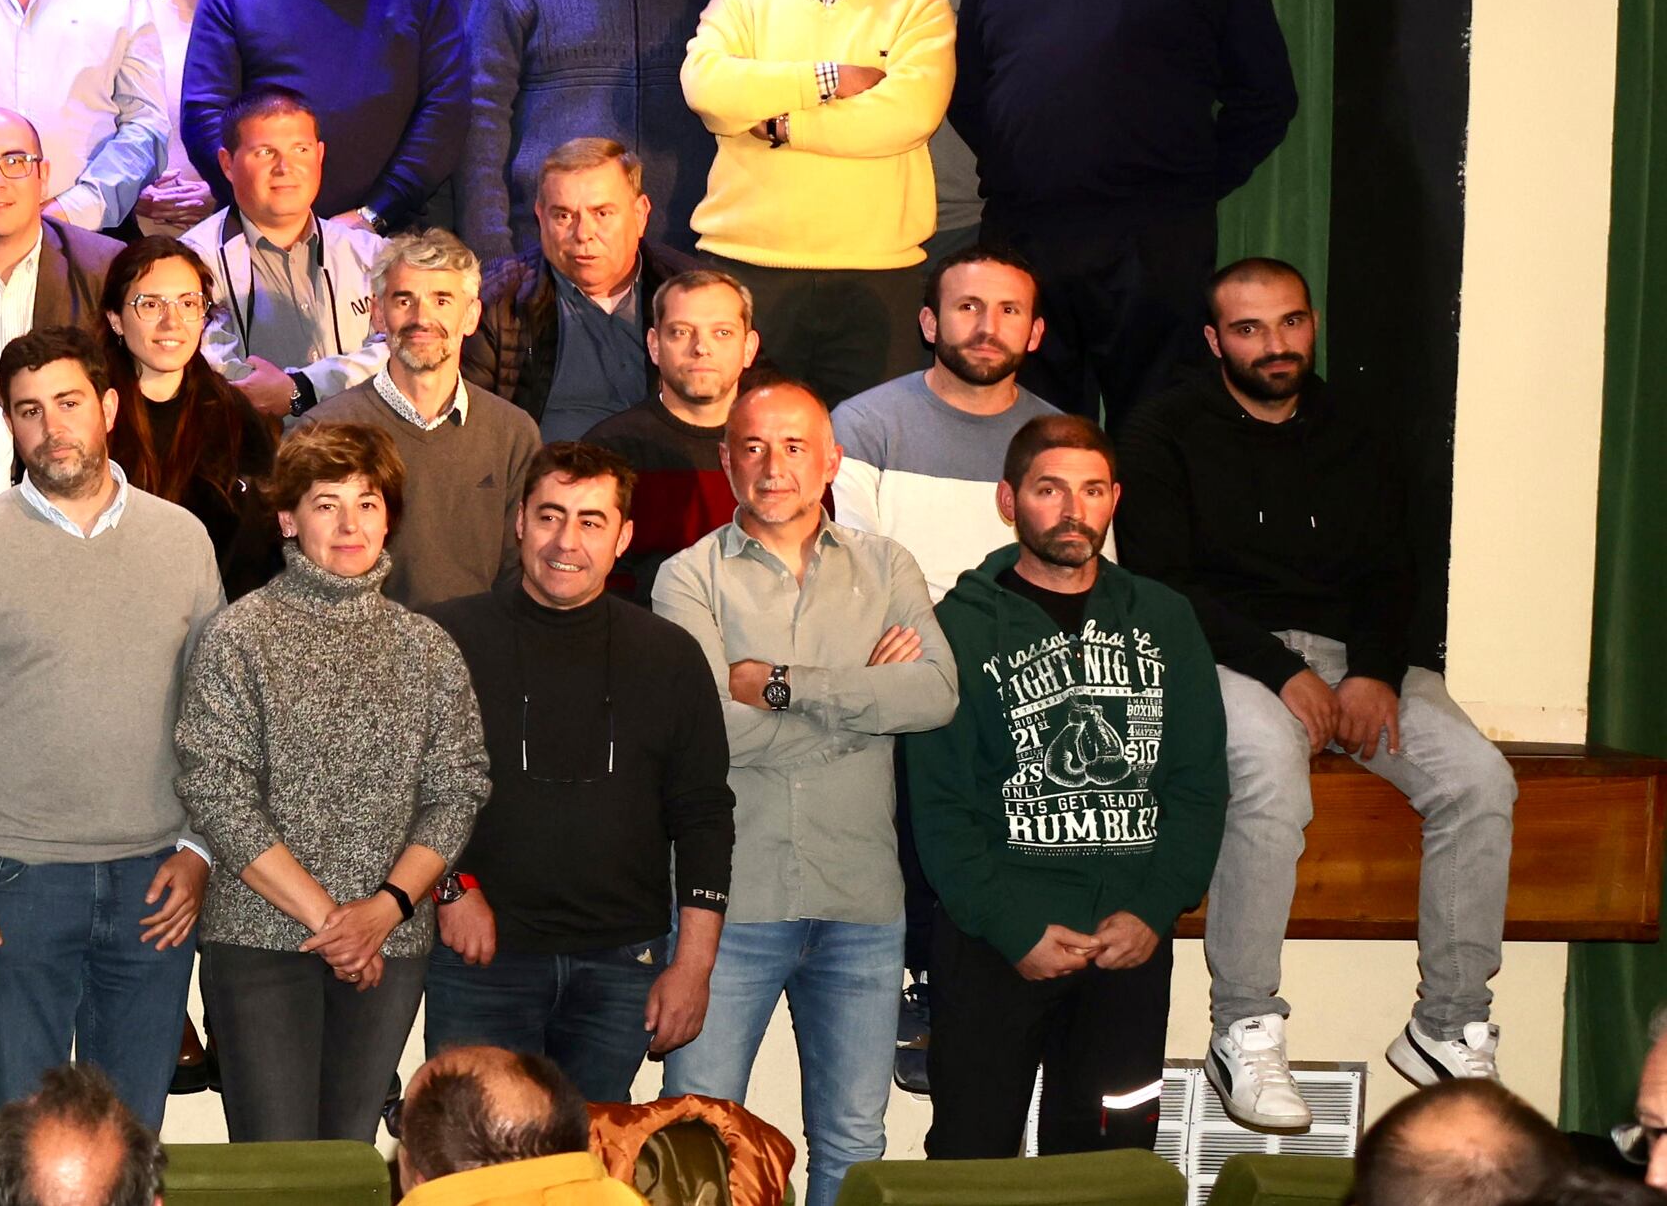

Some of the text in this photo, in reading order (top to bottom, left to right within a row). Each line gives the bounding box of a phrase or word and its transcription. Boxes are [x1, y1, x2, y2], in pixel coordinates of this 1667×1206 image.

[1126, 704, 1163, 718] BOXING
[1123, 739, 1160, 765] $10
[1001, 783, 1042, 799] ONLY
[1004, 800, 1048, 816] LETS
[1057, 794, 1088, 812] GET
[1004, 805, 1159, 844] RUMBLE!
